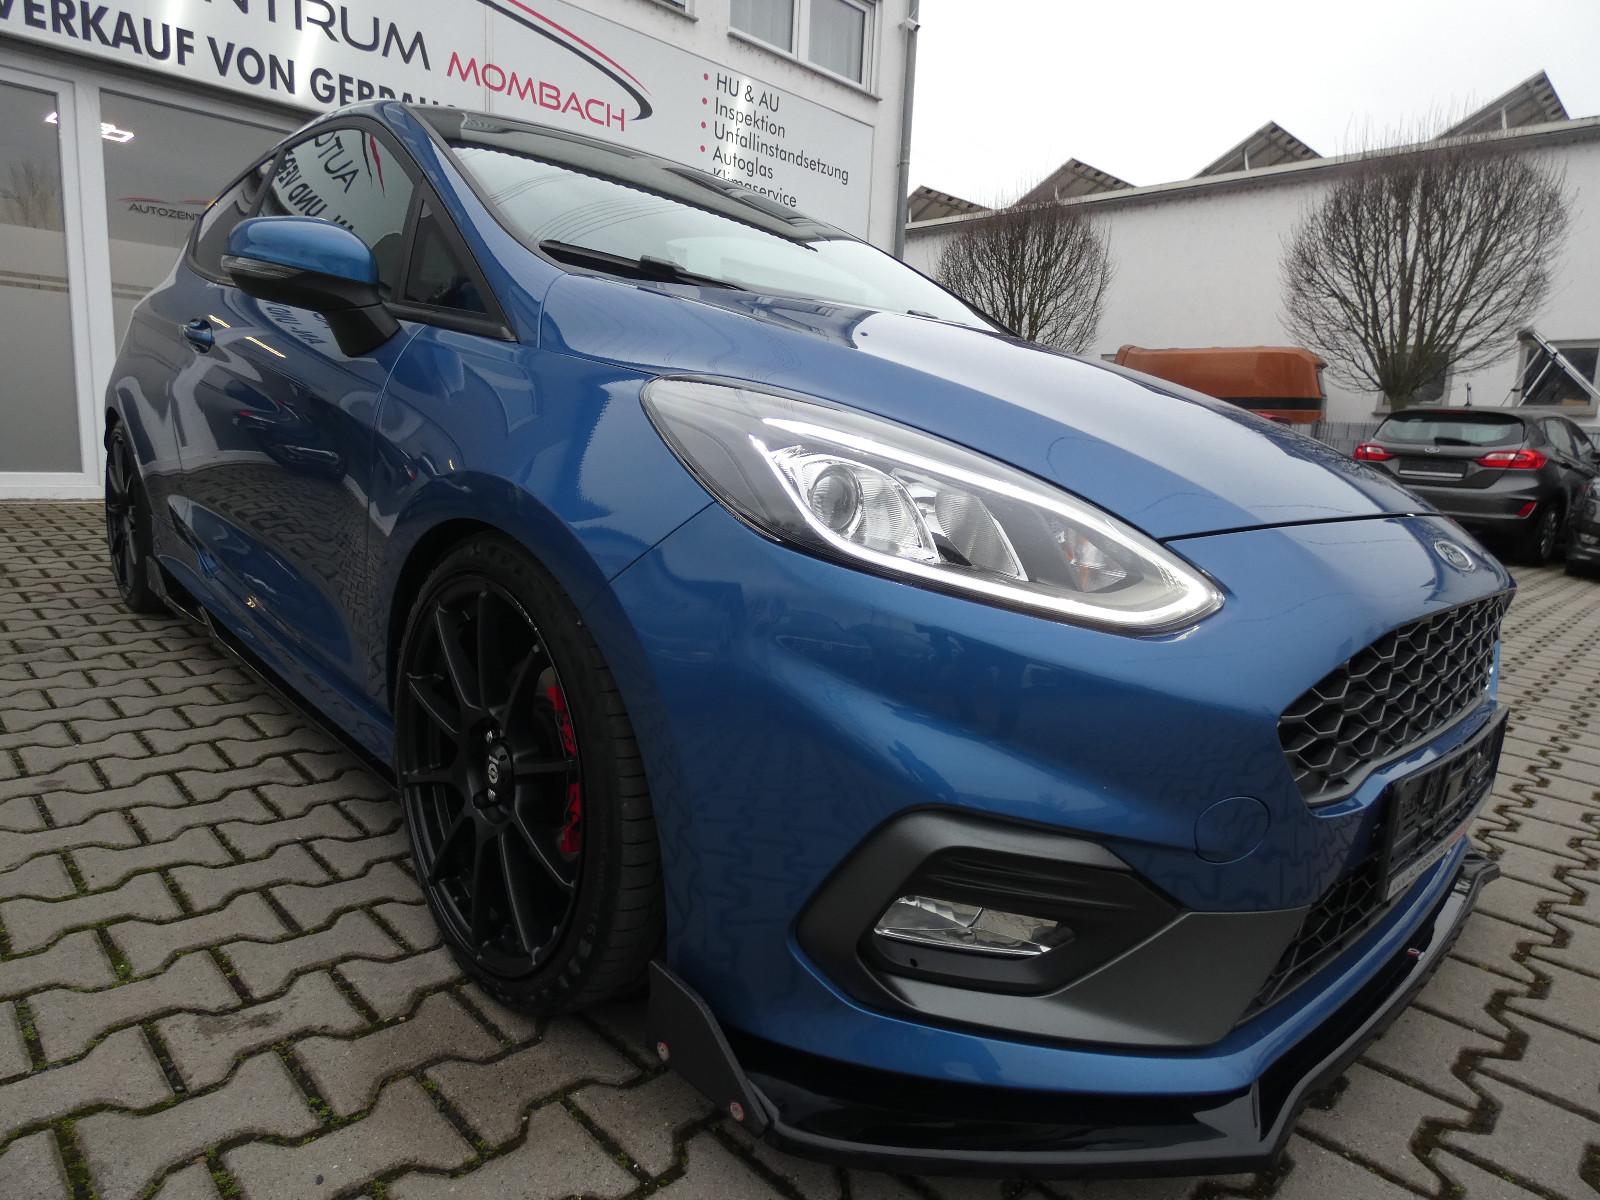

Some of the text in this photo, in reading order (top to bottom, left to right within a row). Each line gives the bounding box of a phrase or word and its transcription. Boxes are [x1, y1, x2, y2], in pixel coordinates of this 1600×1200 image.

[206, 35, 296, 95] VON
[446, 51, 626, 132] MOMBACH
[716, 72, 780, 112] HU & AU
[714, 96, 786, 139] Inspektion
[712, 145, 774, 180] Autoglas
[713, 120, 850, 186] Unfallinstandsetzung
